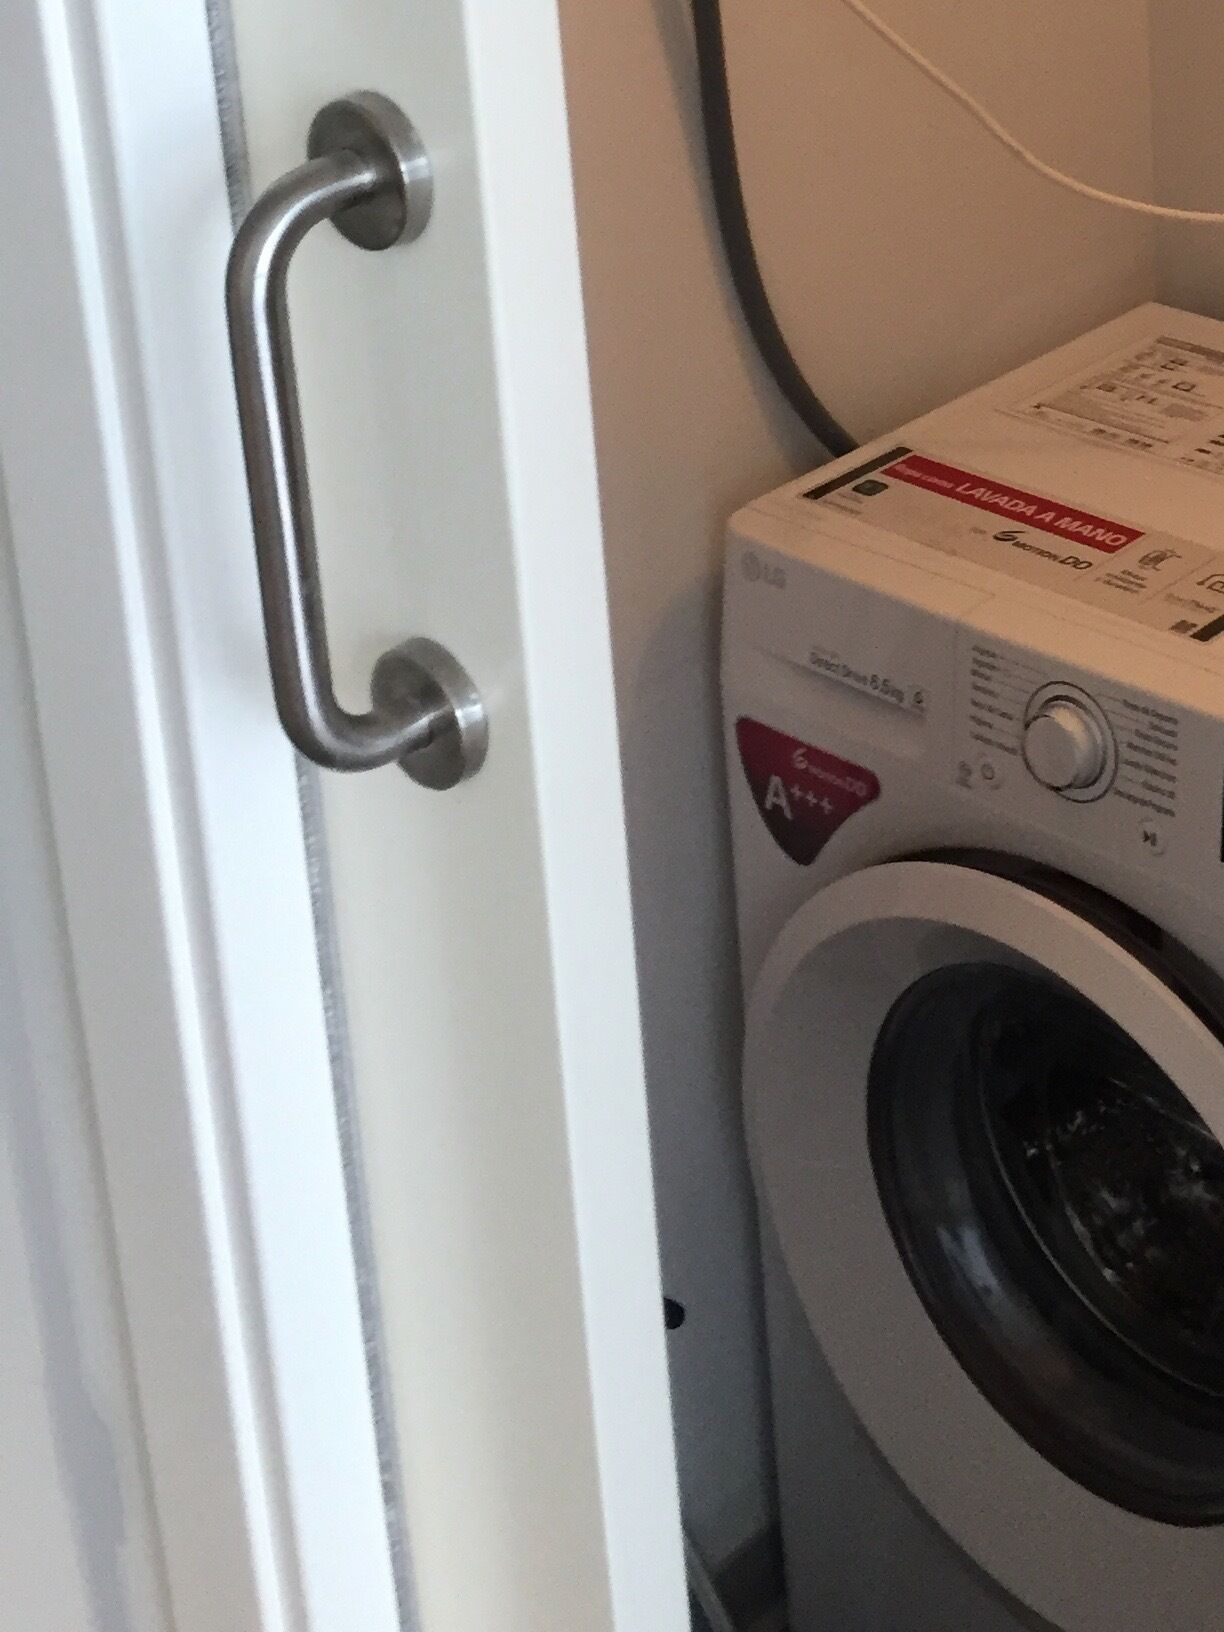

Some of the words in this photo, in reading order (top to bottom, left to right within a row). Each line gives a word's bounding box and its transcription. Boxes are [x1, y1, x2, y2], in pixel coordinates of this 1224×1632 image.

[955, 483, 1037, 517] LAVADA
[1034, 507, 1055, 522] A
[1055, 515, 1129, 547] MANO
[764, 774, 835, 820] A+++
